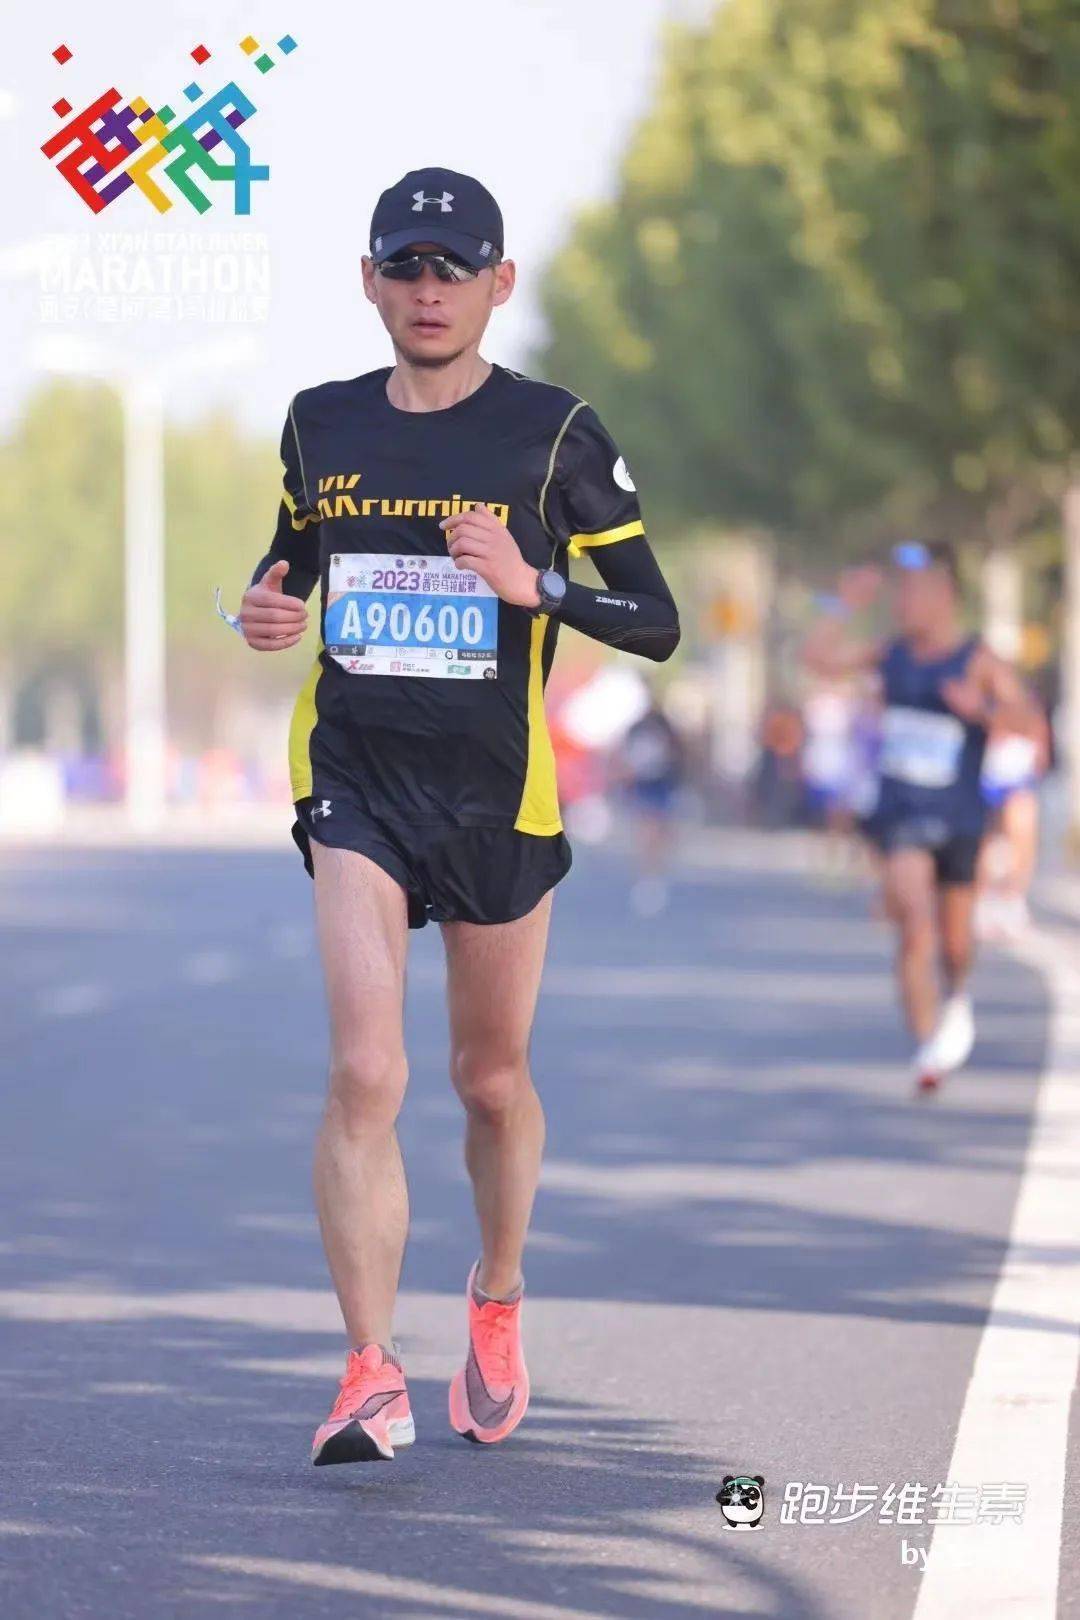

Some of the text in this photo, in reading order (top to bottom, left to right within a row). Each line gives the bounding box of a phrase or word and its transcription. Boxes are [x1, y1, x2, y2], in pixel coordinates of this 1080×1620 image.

[372, 570, 420, 592] 2023
[422, 578, 477, 593] 西安马拉松赛
[442, 572, 477, 582] MARATHON
[340, 599, 484, 645] A90600
